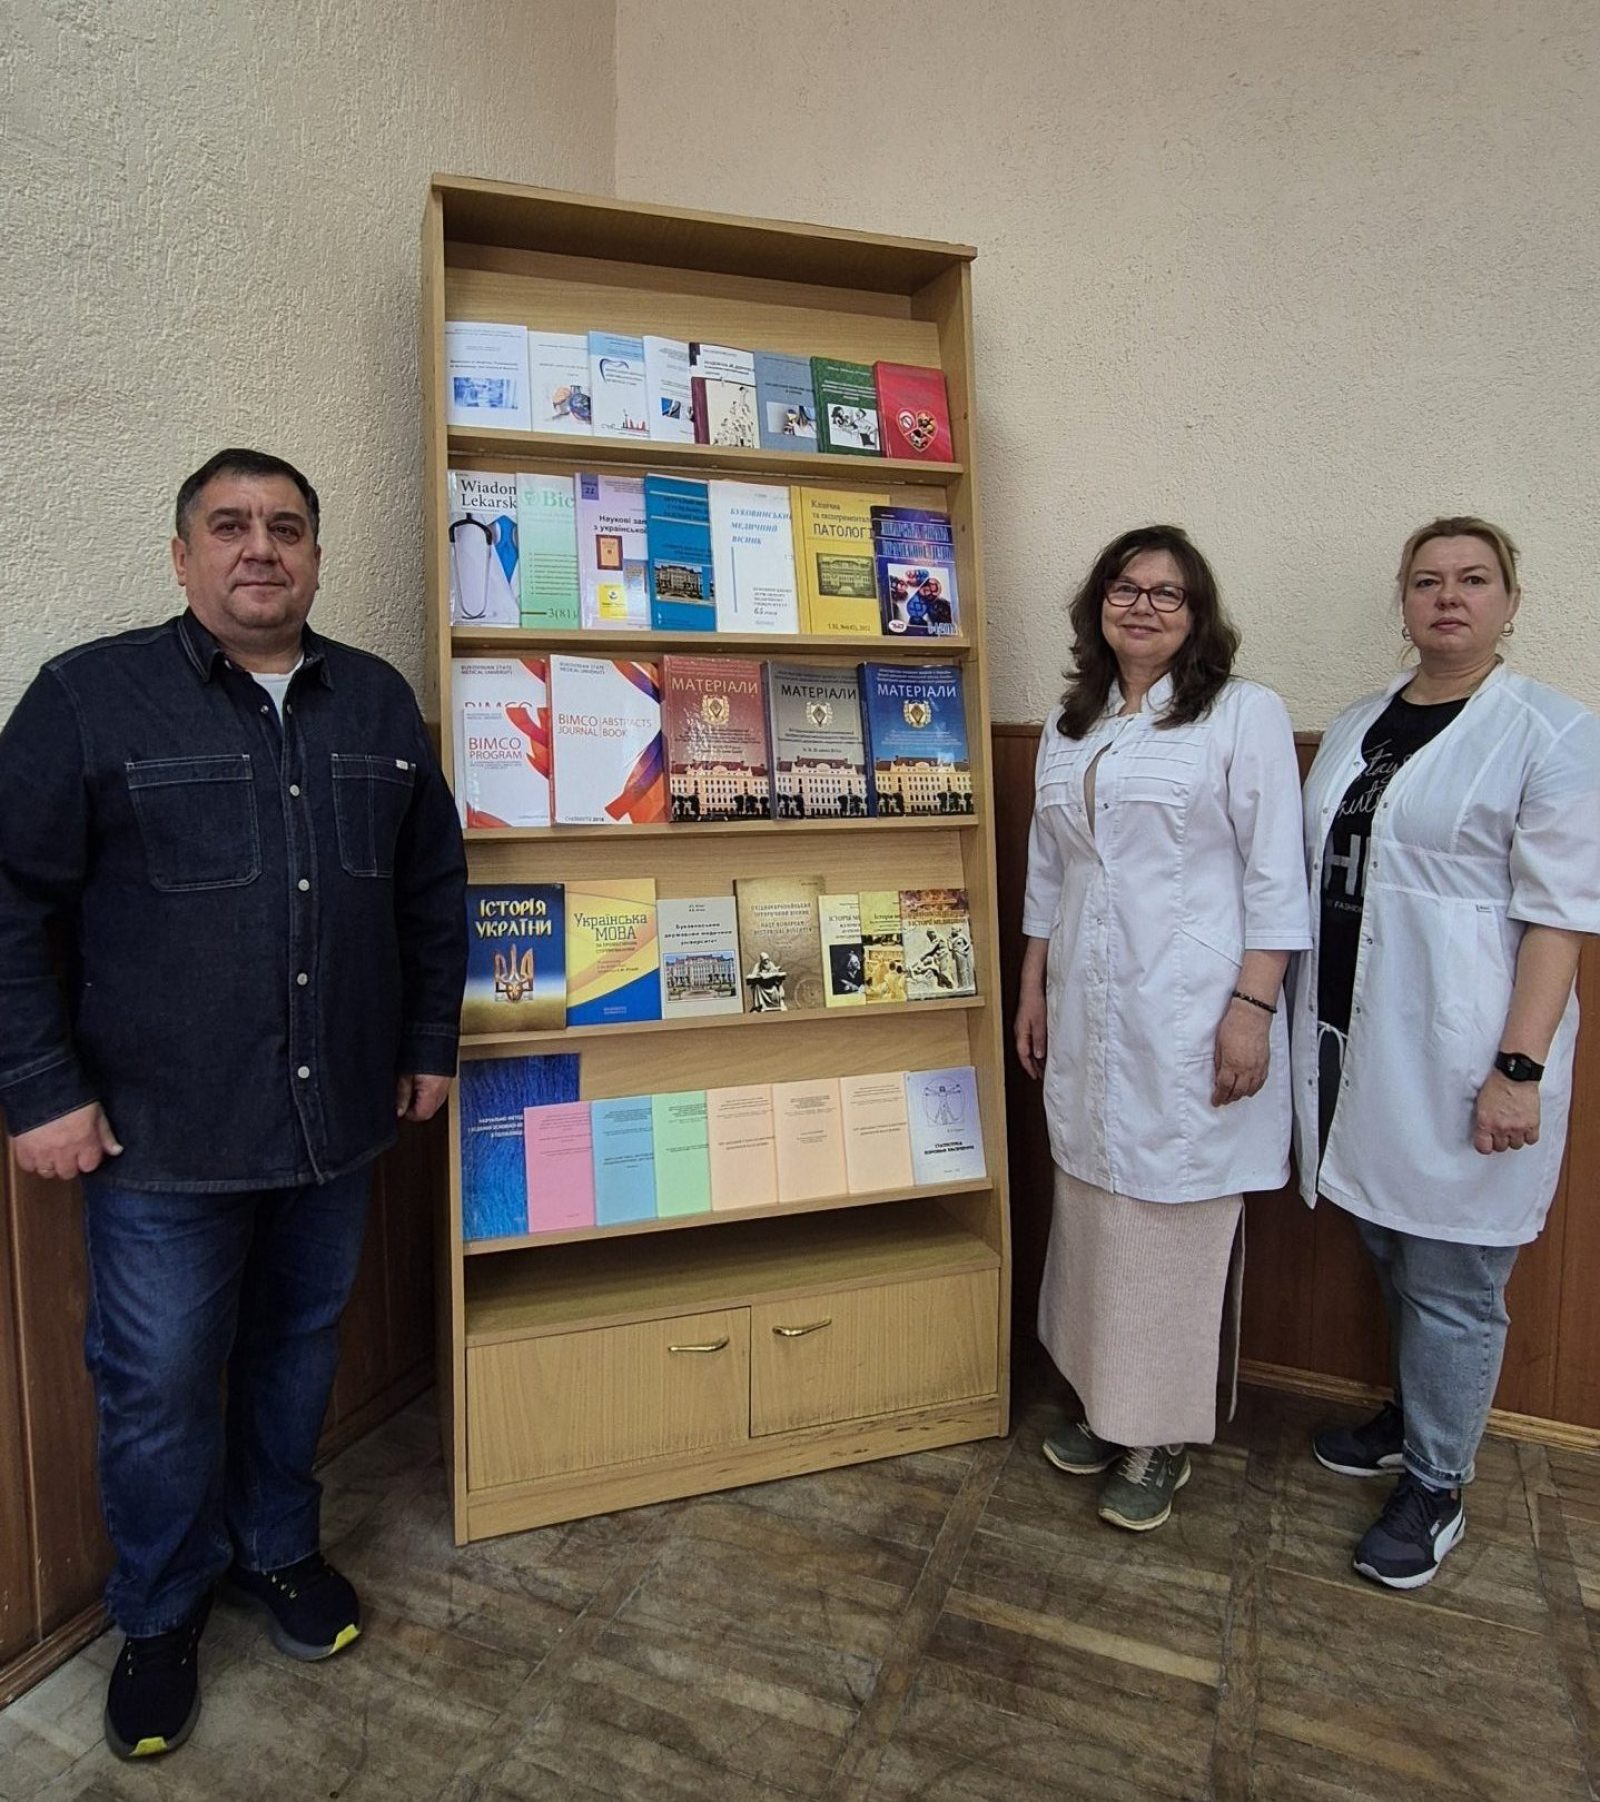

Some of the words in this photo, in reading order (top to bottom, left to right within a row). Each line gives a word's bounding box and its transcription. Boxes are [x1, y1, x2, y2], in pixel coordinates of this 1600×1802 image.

[671, 677, 759, 694] МАТЕРІАЛИ
[781, 684, 857, 700] МАТЕРІАЛИ
[877, 683, 957, 698] МАТЕРІАЛИ
[558, 713, 598, 727] BIMCO
[558, 724, 598, 737] JOURNAL
[602, 728, 626, 738] BOOK
[469, 737, 521, 751] BIMCO
[470, 750, 523, 760] PROGRAM
[480, 898, 547, 918] ІСТОРІЯ
[476, 918, 552, 939] УКРАЇНИ
[573, 912, 648, 930] Українська
[595, 925, 637, 941] МОВА
